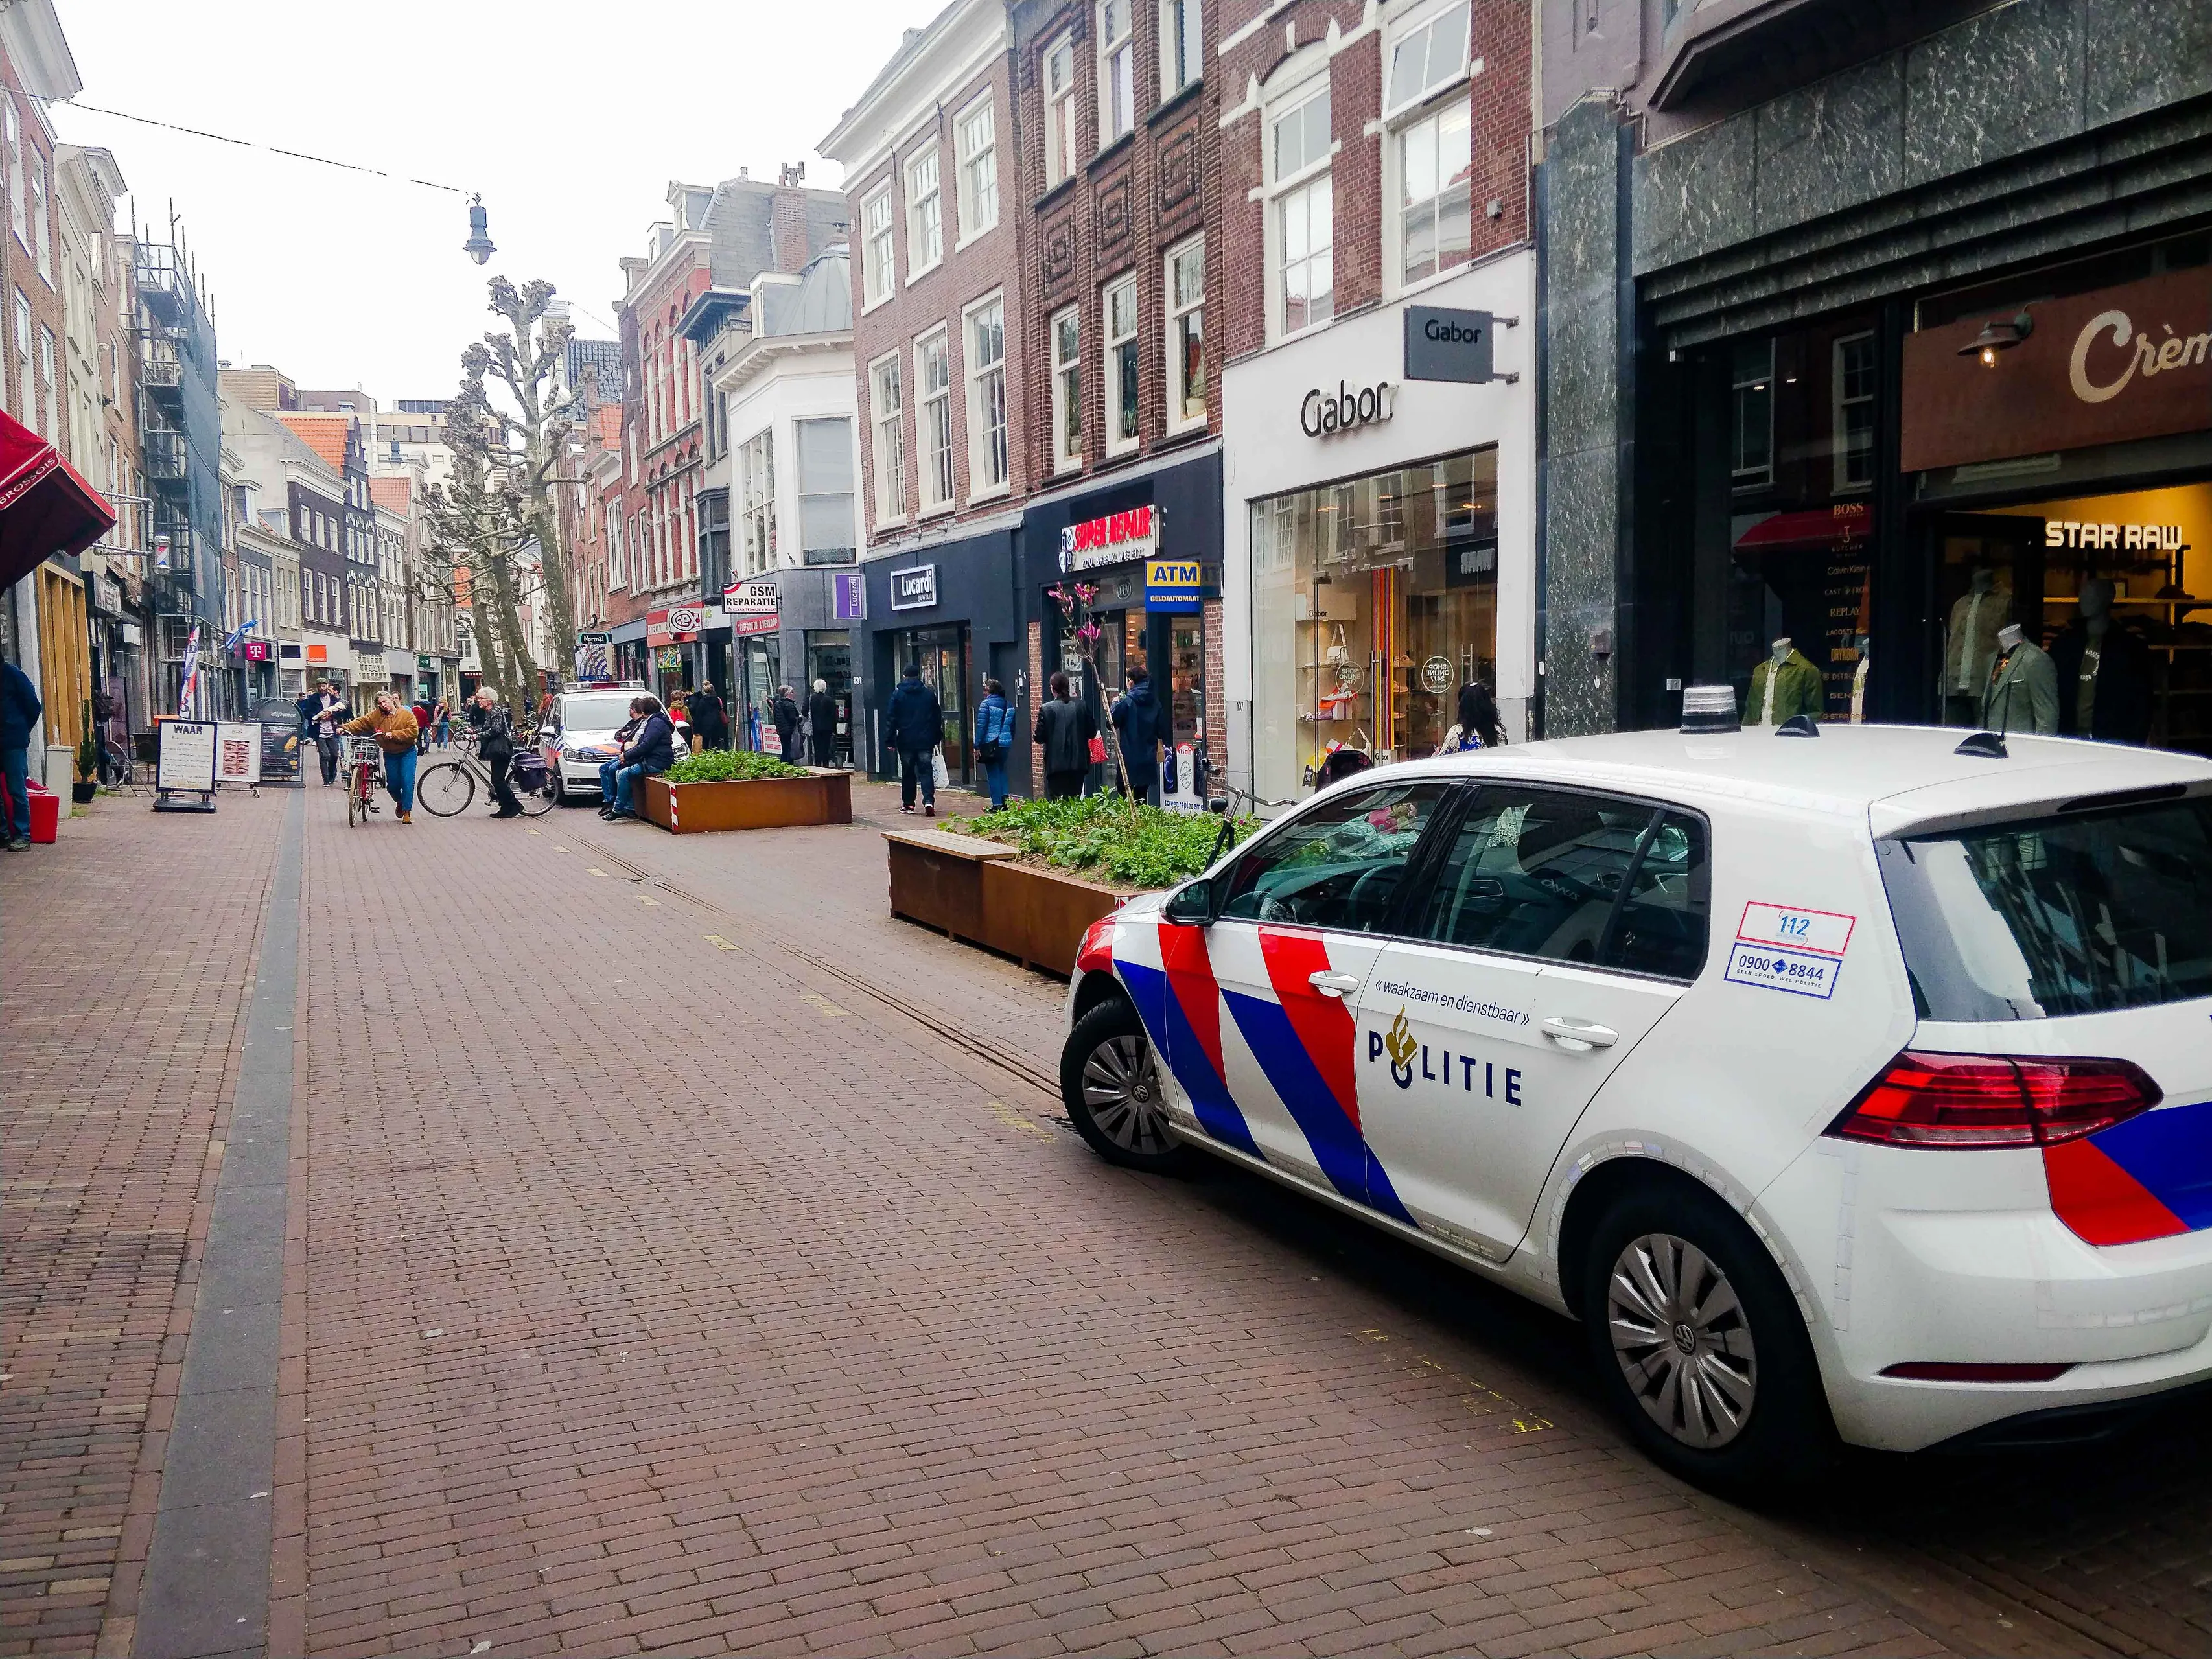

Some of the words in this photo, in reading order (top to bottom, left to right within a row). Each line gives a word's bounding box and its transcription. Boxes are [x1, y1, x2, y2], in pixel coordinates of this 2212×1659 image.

[1425, 319, 1482, 343] Gabor
[1301, 379, 1390, 438] Gabor
[1834, 502, 1863, 516] BOSS
[1075, 517, 1107, 551] SUPER
[1108, 507, 1151, 543] REPAIR
[2045, 521, 2119, 549] STAR
[2125, 524, 2182, 550] RAW
[1153, 566, 1198, 583] ATM
[902, 570, 932, 596] Lucardi
[750, 586, 775, 596] GSM
[727, 597, 776, 606] REPARATIE
[1830, 607, 1861, 617] REPLAY
[853, 676, 862, 684] 131
[174, 725, 203, 734] WAAR
[1179, 801, 1204, 810] replaceme
[1739, 955, 1770, 971] 0900
[1789, 963, 1825, 980] 8844
[1795, 979, 1822, 988] POLITIE
[1440, 995, 1454, 1008] en
[1369, 1030, 1522, 1107] POLITIE
